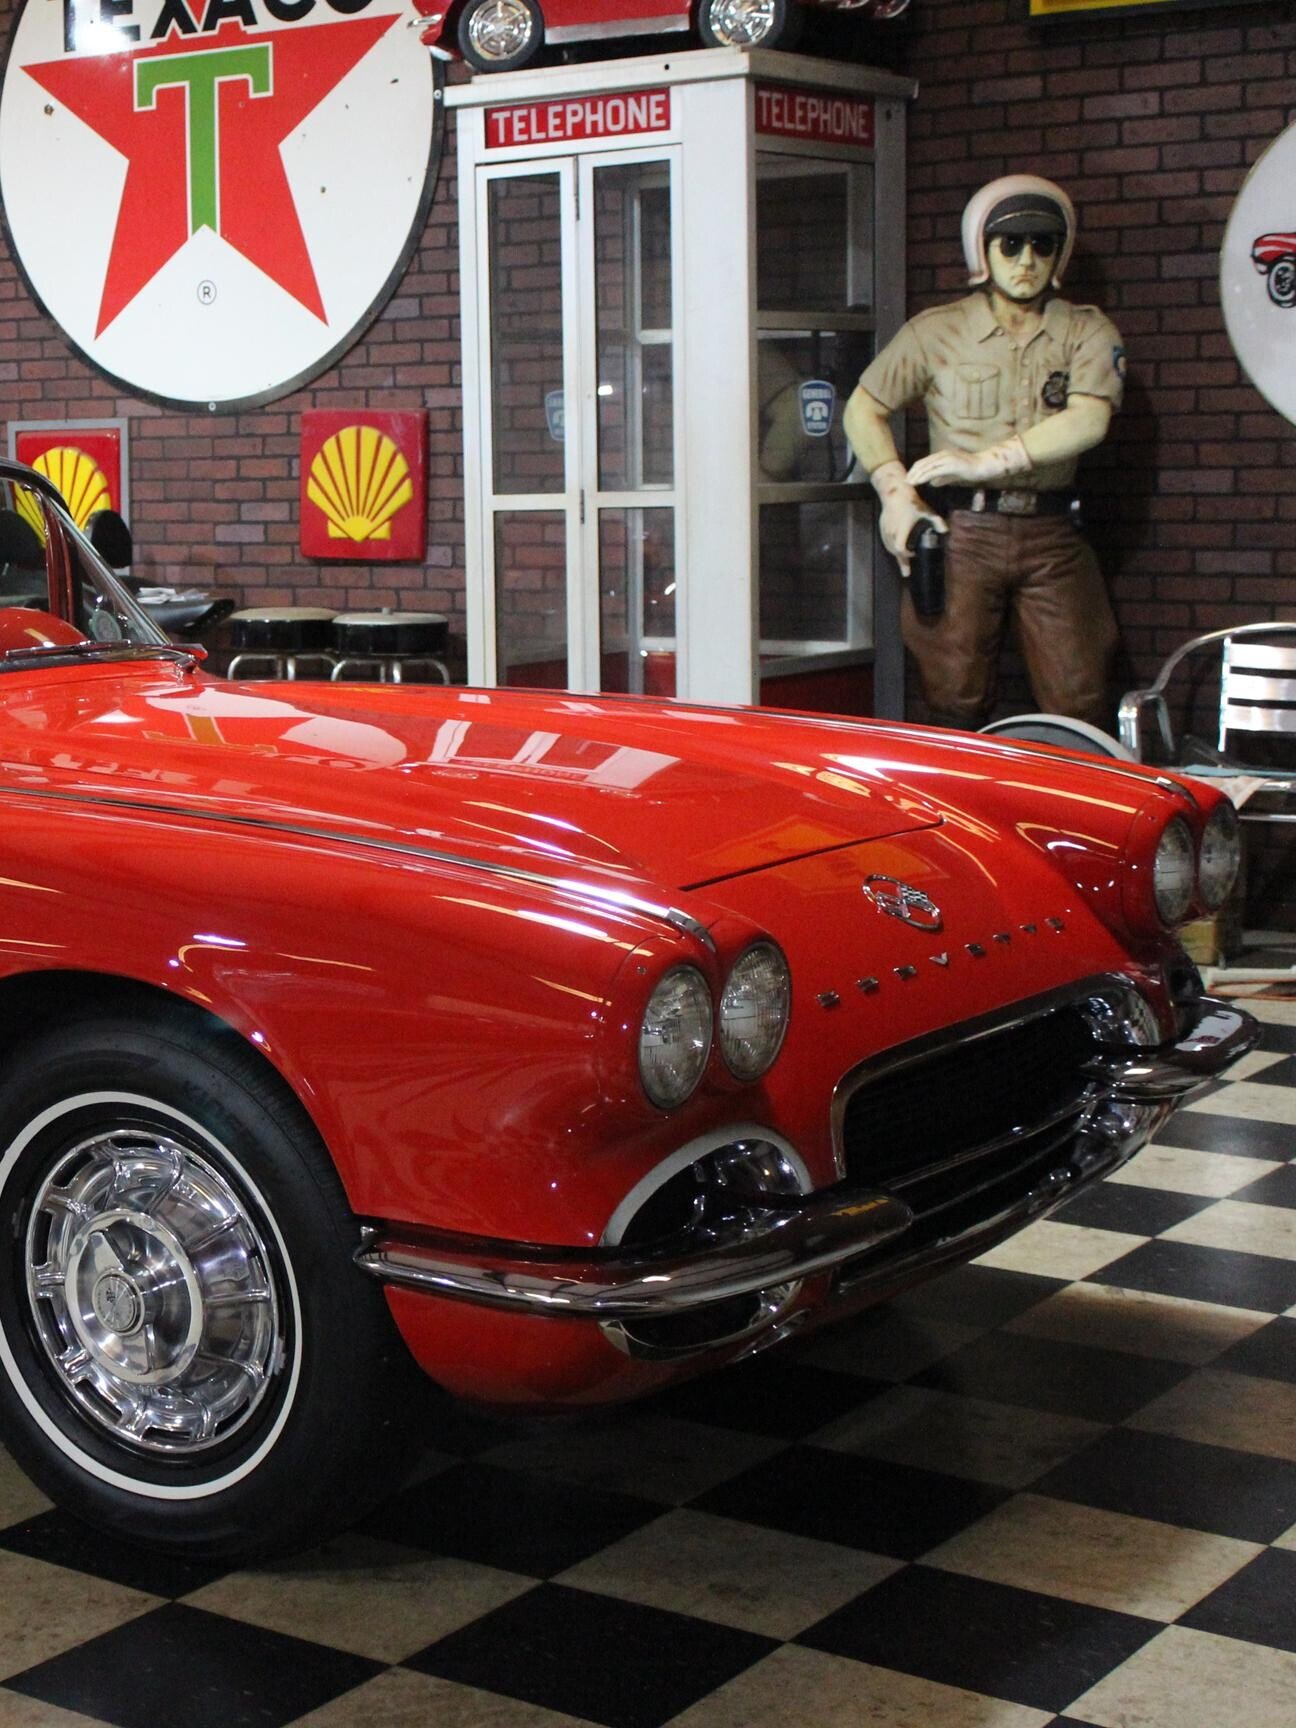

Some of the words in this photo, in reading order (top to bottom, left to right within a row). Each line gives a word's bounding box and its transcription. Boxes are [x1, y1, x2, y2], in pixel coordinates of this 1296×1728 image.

[64, 0, 372, 52] TEXA
[491, 94, 667, 144] TELEPHONE
[758, 90, 870, 139] TELEPHONE
